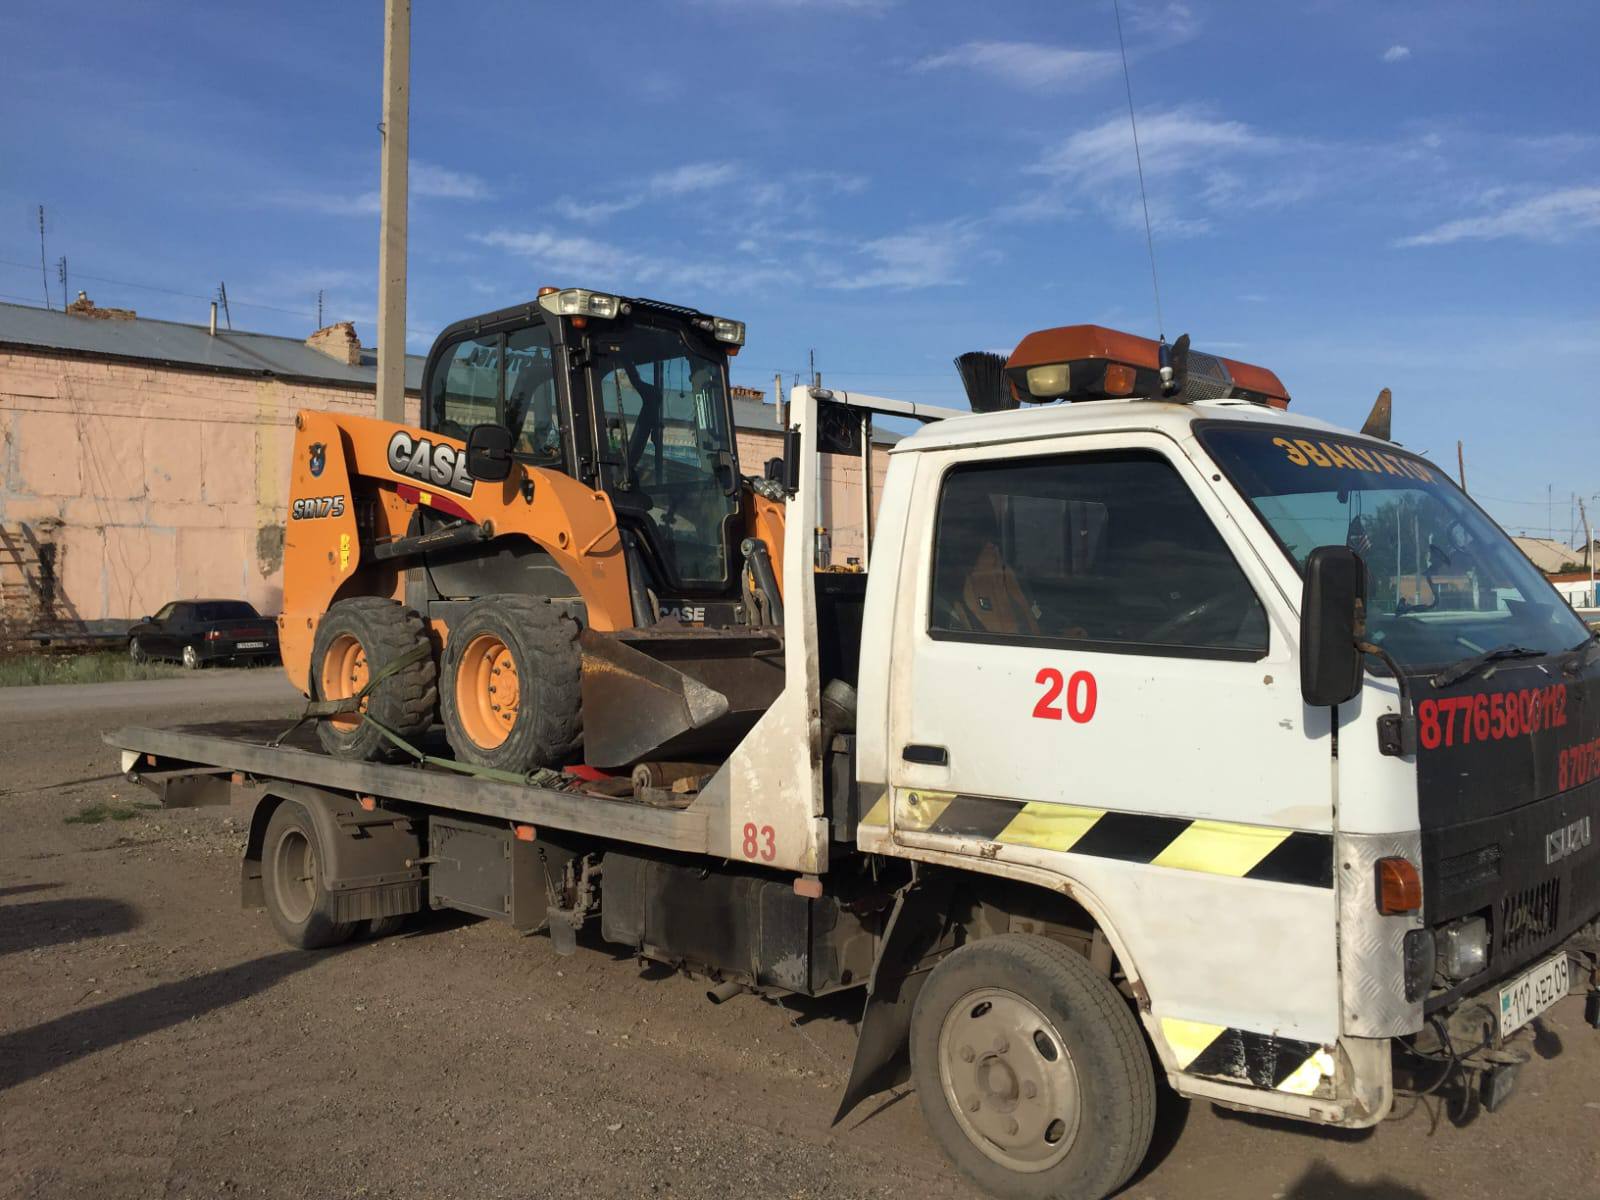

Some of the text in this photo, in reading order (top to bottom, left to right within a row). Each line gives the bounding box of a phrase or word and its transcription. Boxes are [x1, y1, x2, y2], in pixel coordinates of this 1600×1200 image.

[387, 430, 474, 497] CASE
[1032, 668, 1098, 724] 20
[742, 822, 777, 862] 83
[1546, 816, 1590, 864] ISUZU
